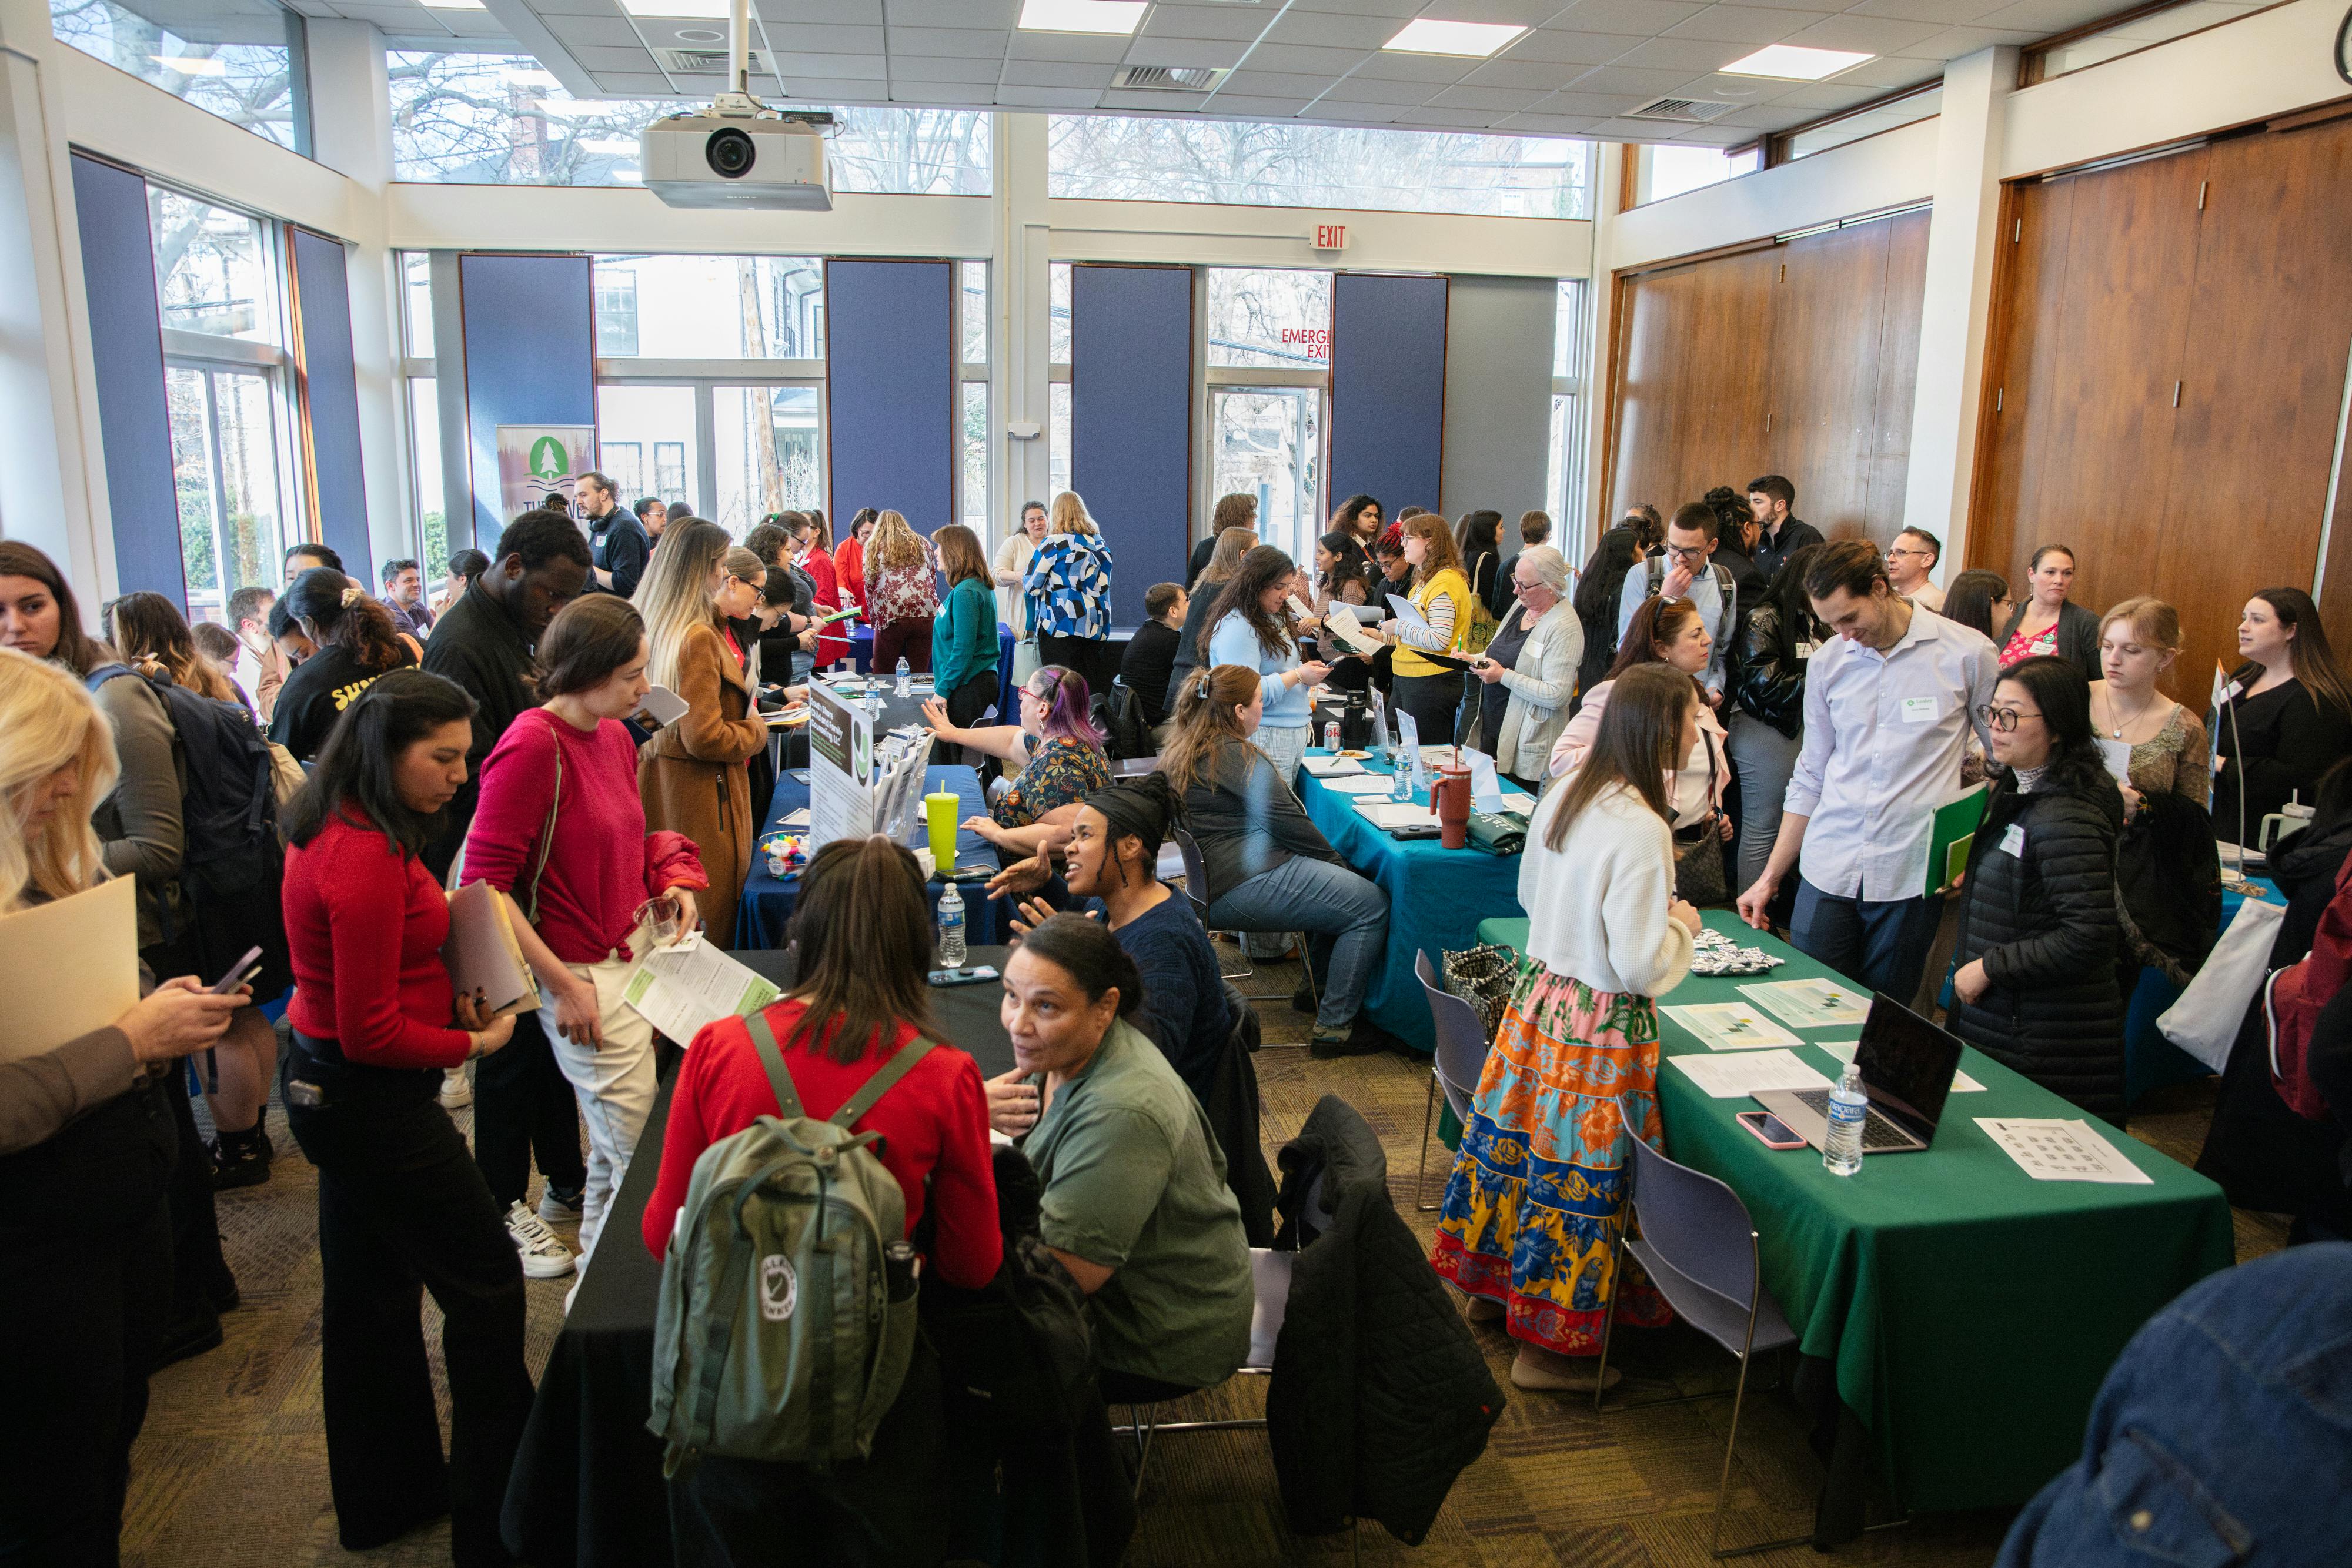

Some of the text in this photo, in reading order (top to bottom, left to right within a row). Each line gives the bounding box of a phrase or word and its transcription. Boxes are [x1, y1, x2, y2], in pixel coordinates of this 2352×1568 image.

[1318, 226, 1345, 248] EXIT
[811, 697, 834, 720] South Shore
[829, 721, 843, 740] Family
[1830, 1101, 1860, 1117] niagara
